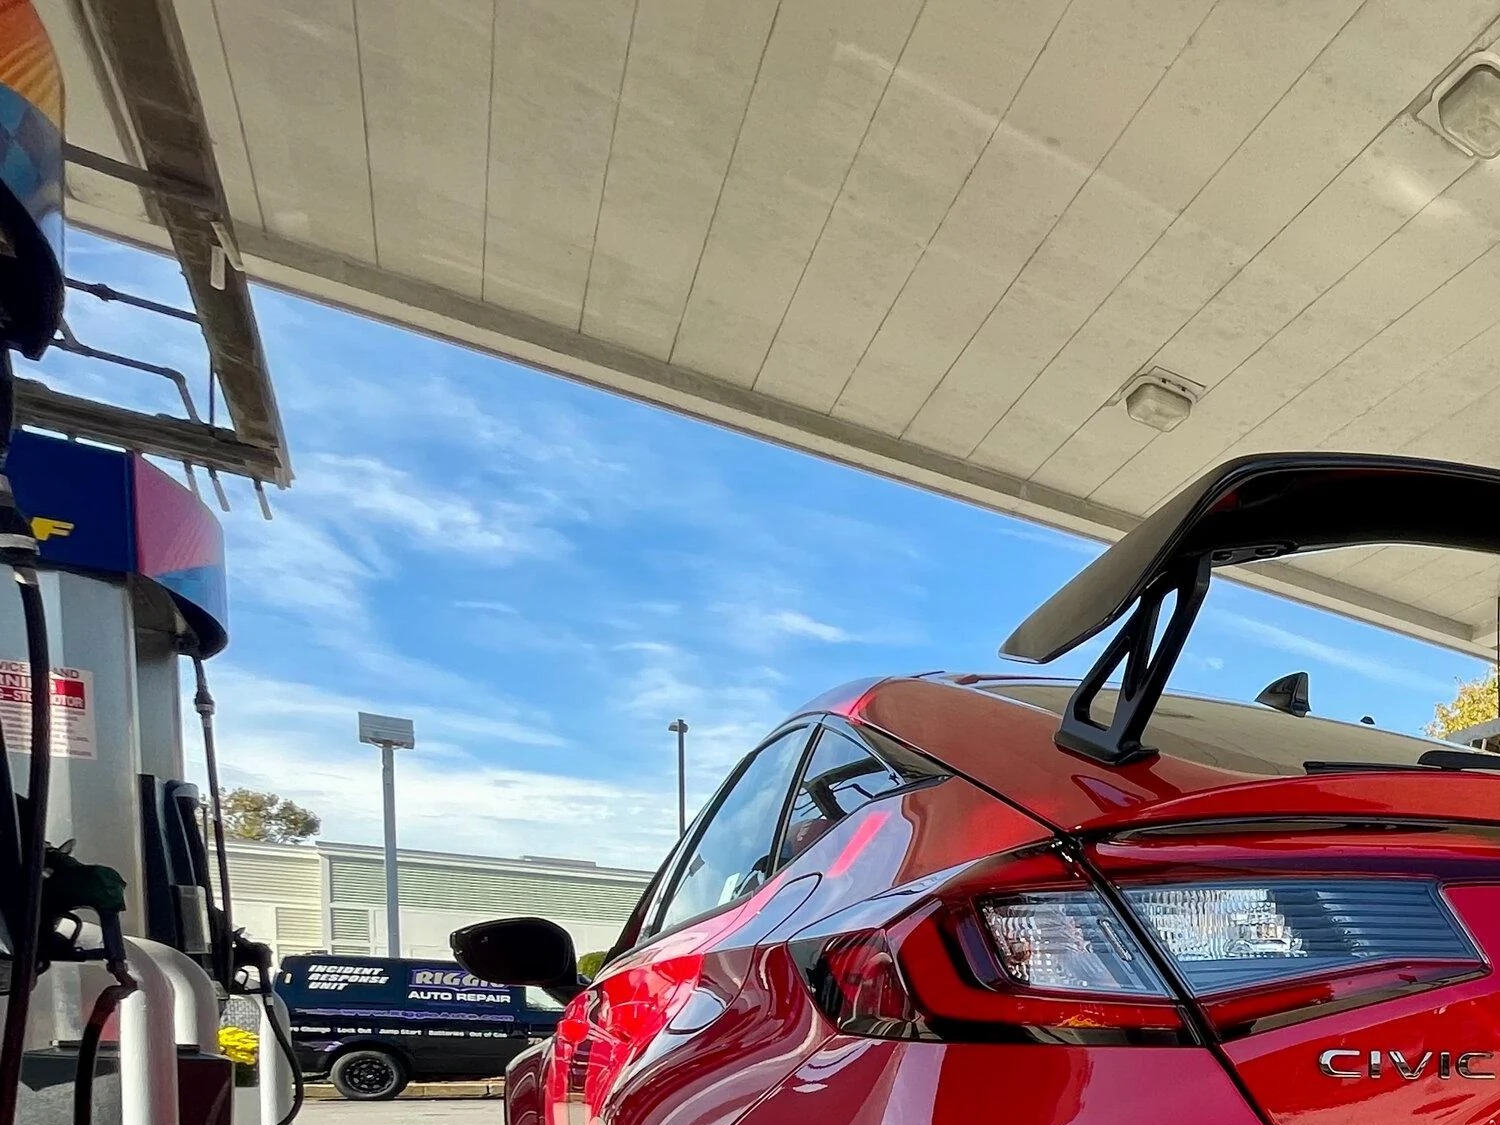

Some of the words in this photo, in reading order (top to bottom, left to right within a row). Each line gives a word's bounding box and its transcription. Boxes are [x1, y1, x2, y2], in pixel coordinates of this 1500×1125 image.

[308, 964, 384, 976] INCIDENT
[308, 973, 390, 984] RESPONSE
[308, 982, 349, 991] UNIT
[408, 991, 453, 1000] AUTO
[456, 993, 511, 1003] REPAIR
[1318, 1048, 1496, 1080] CIVIC
